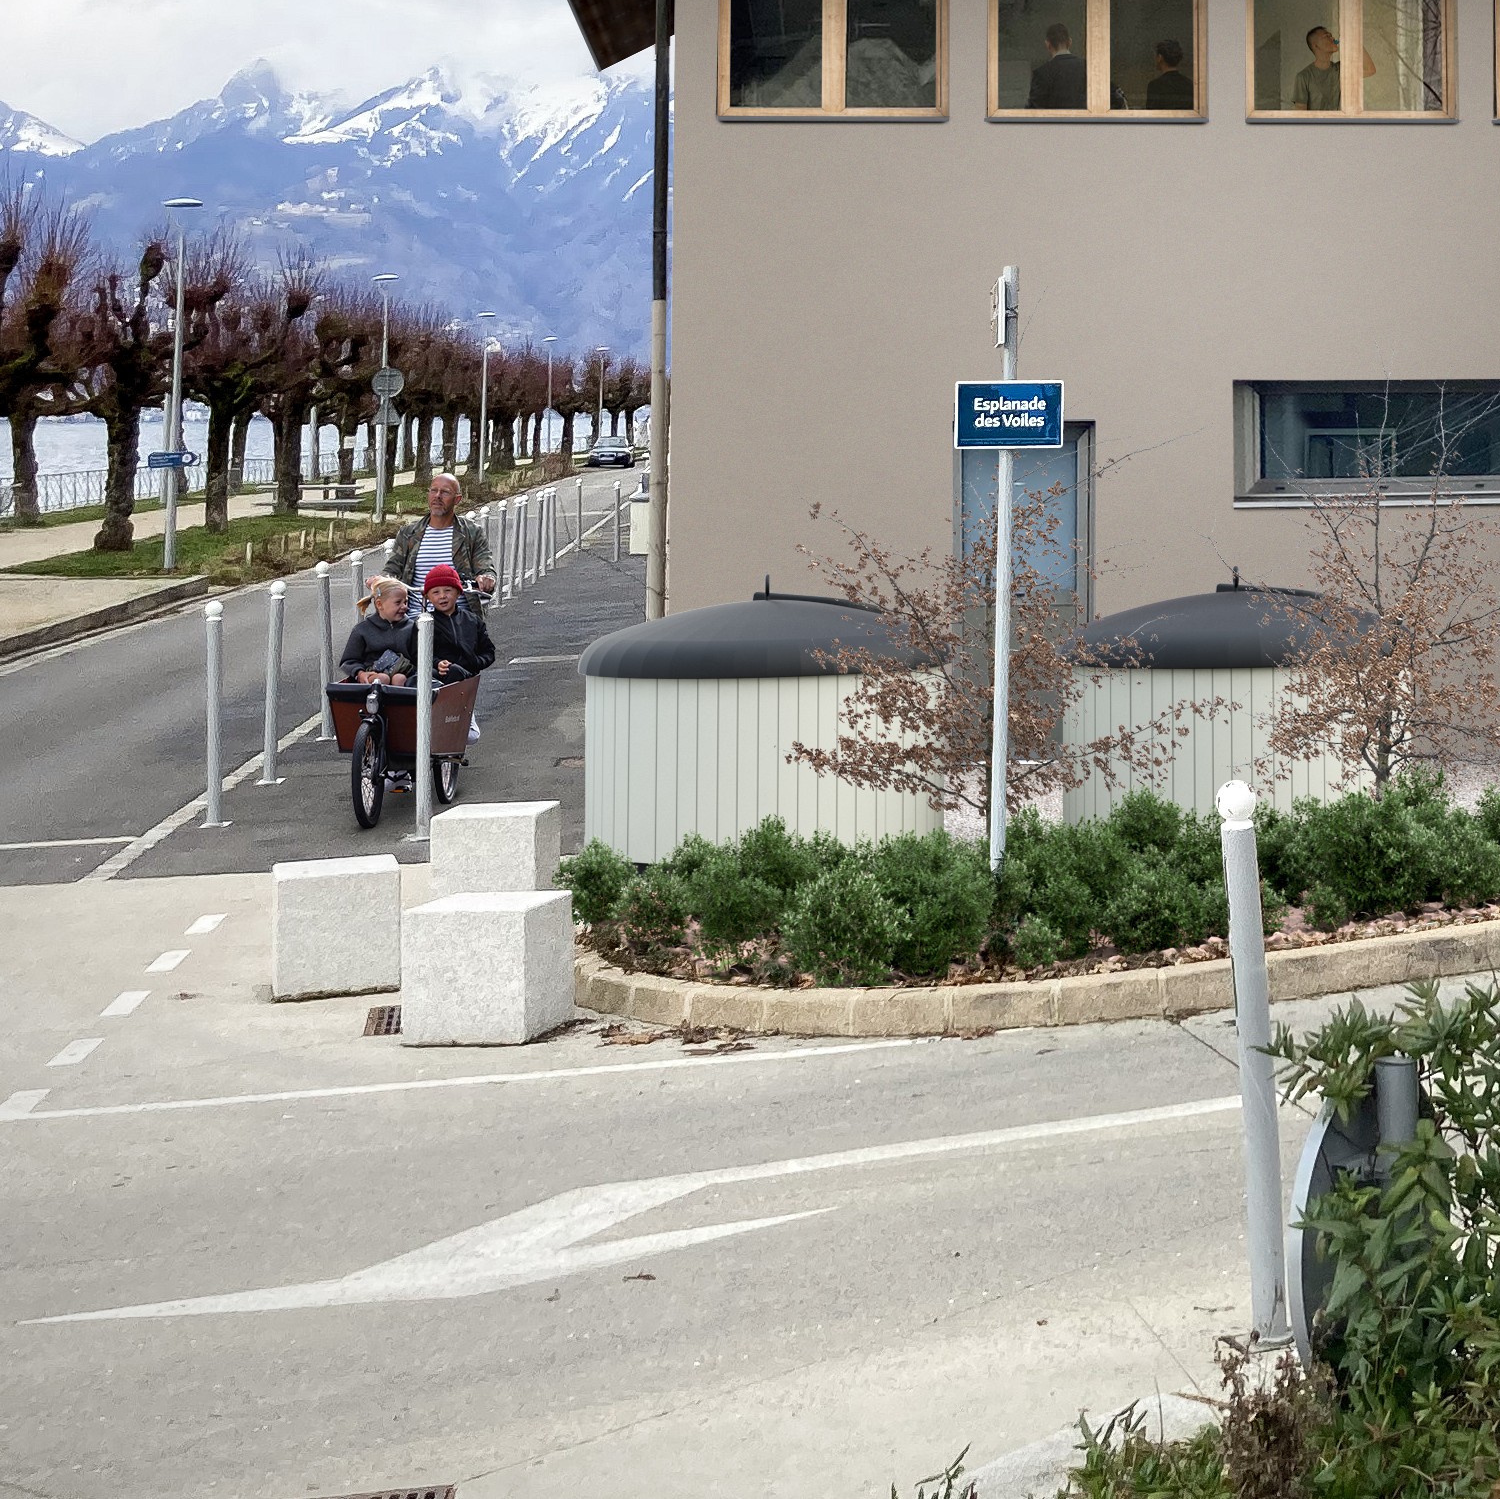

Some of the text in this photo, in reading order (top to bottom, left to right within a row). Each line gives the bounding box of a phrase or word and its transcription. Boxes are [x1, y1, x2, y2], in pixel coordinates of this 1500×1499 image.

[973, 396, 1047, 415] Esplanade
[974, 412, 1045, 428] des Voiles
